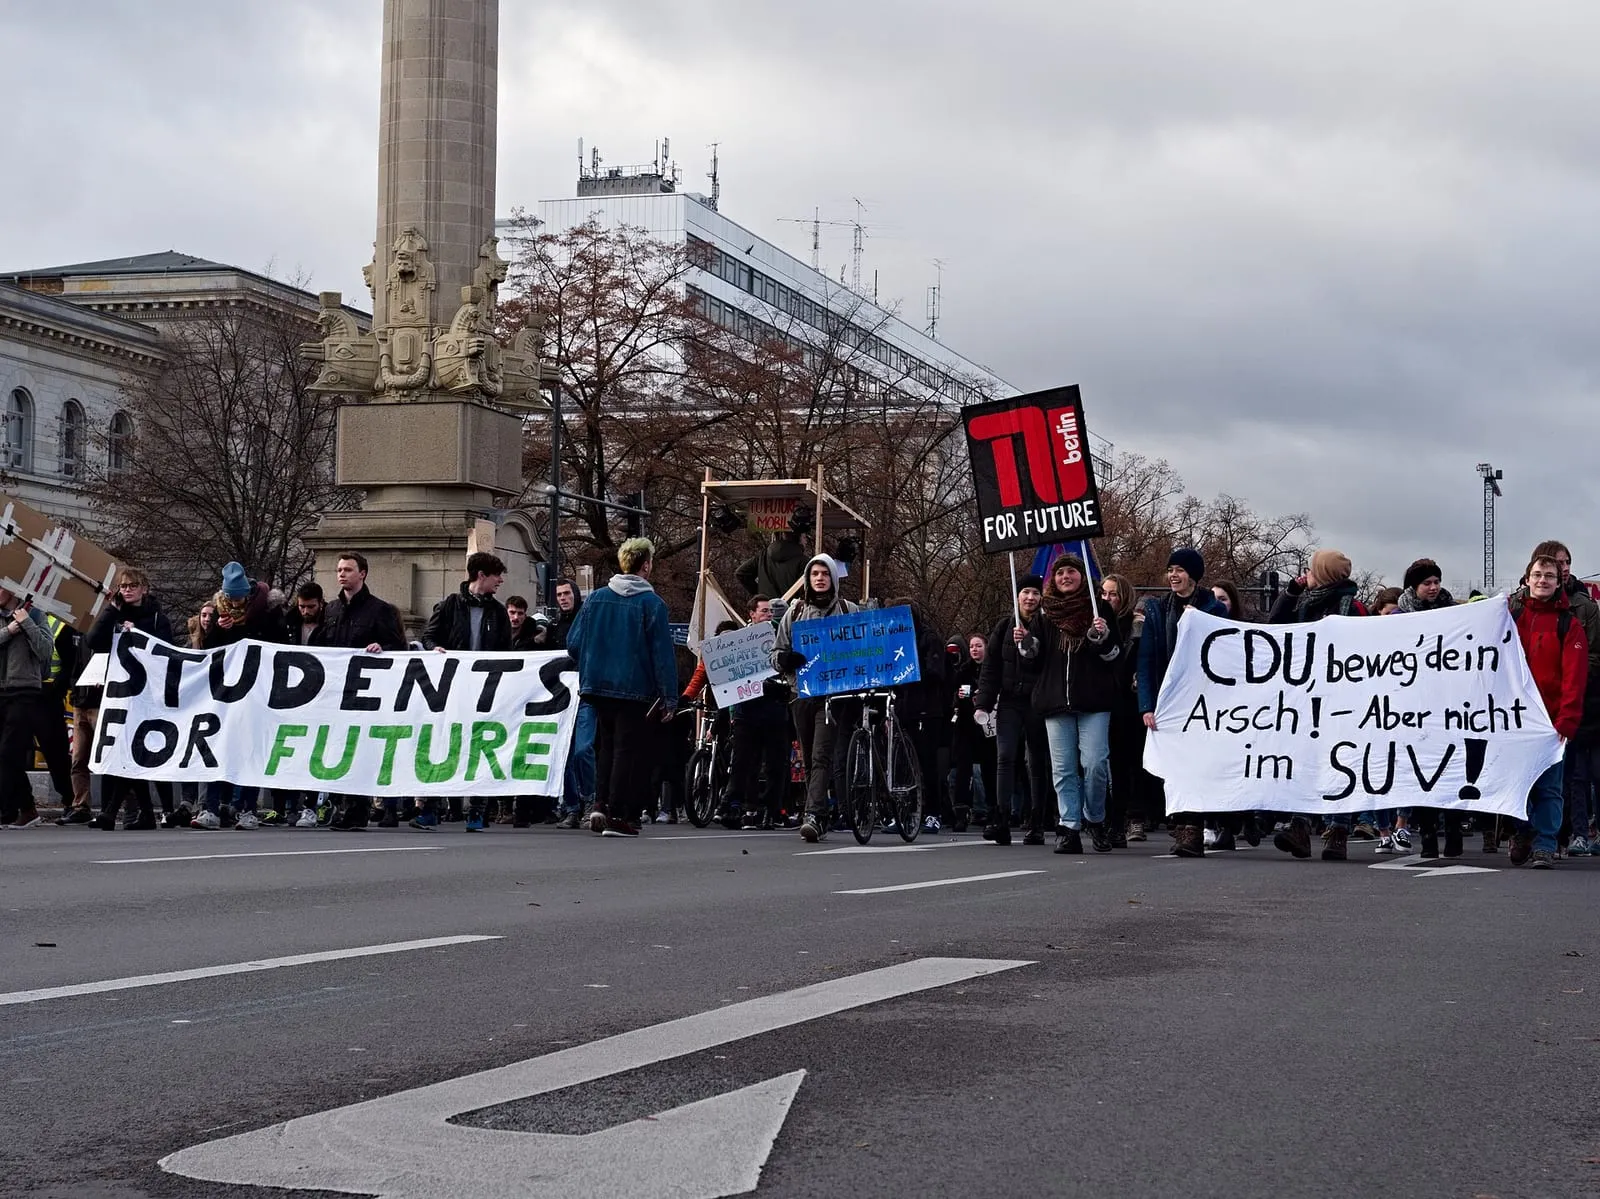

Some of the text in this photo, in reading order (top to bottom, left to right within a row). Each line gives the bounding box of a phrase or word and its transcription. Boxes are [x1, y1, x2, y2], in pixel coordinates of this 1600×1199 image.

[1056, 412, 1082, 464] berlin
[757, 516, 790, 530] MOBIL
[983, 500, 1097, 543] FOR FUTURE
[717, 638, 736, 651] have
[746, 630, 773, 642] dream
[801, 622, 912, 646] Die WELT ist voller
[106, 630, 579, 717] STUDENTS
[709, 646, 758, 672] CLIMATE
[728, 660, 772, 682] JUSTIC
[853, 664, 867, 677] SIE
[876, 661, 893, 673] UM
[1200, 627, 1317, 693] CDU,
[1358, 695, 1432, 730] Aber
[1445, 693, 1527, 733] nicht
[95, 708, 558, 787] FOR FUTURE
[1244, 737, 1489, 801] im SUV!
